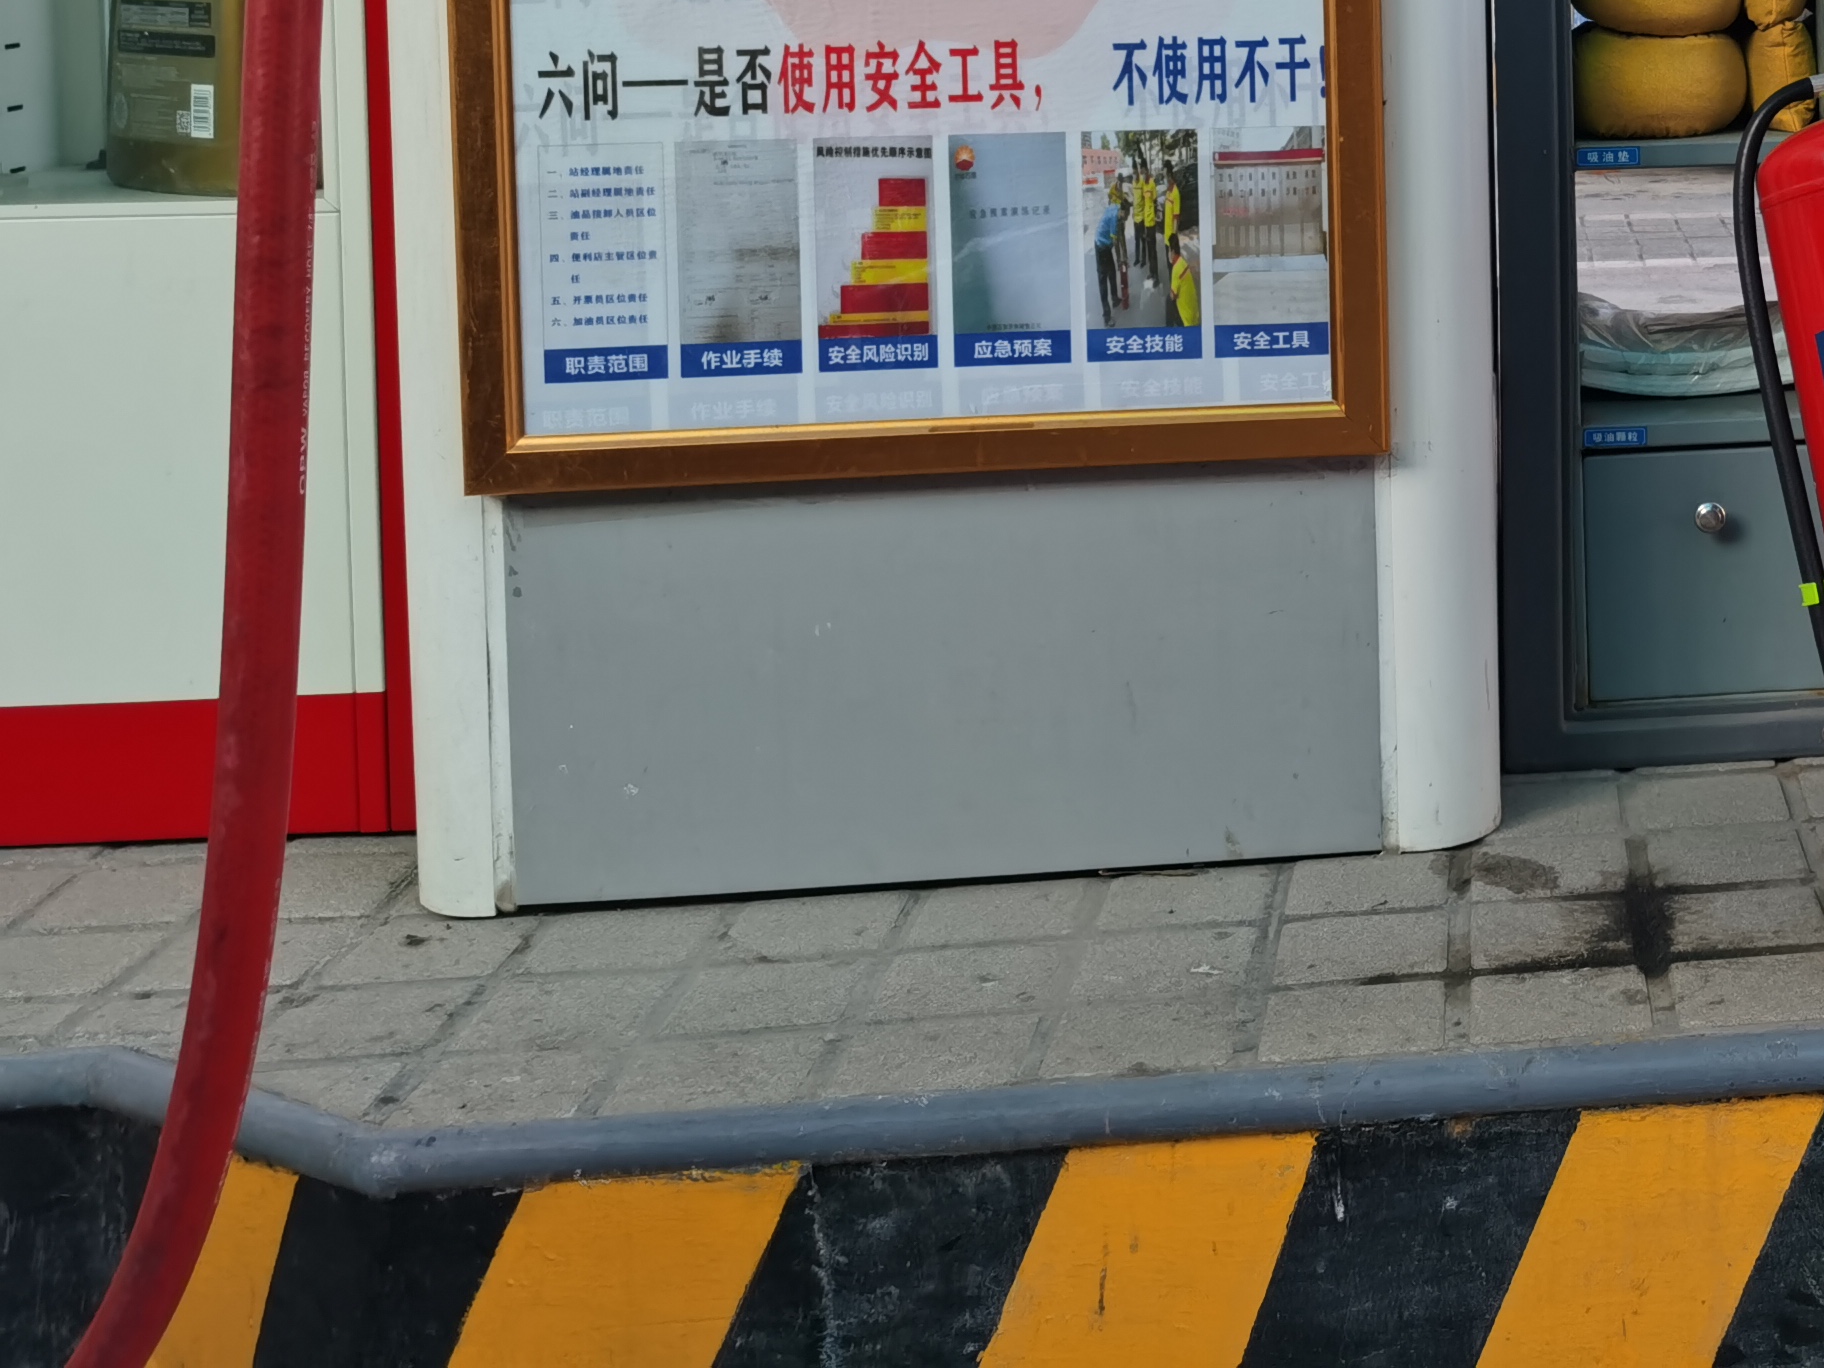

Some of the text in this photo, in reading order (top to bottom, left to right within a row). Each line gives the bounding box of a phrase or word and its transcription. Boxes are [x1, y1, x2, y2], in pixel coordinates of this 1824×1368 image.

[1587, 150, 1630, 163] 吸油垫
[974, 339, 1053, 360] 应急预案
[1106, 334, 1183, 355] 安全技能
[1233, 330, 1310, 351] 安全工具
[565, 353, 648, 375] 职责范围
[701, 348, 783, 370] 作业手续
[828, 343, 929, 365] 安全风险识别
[1593, 432, 1638, 443] 吸油颗粒
